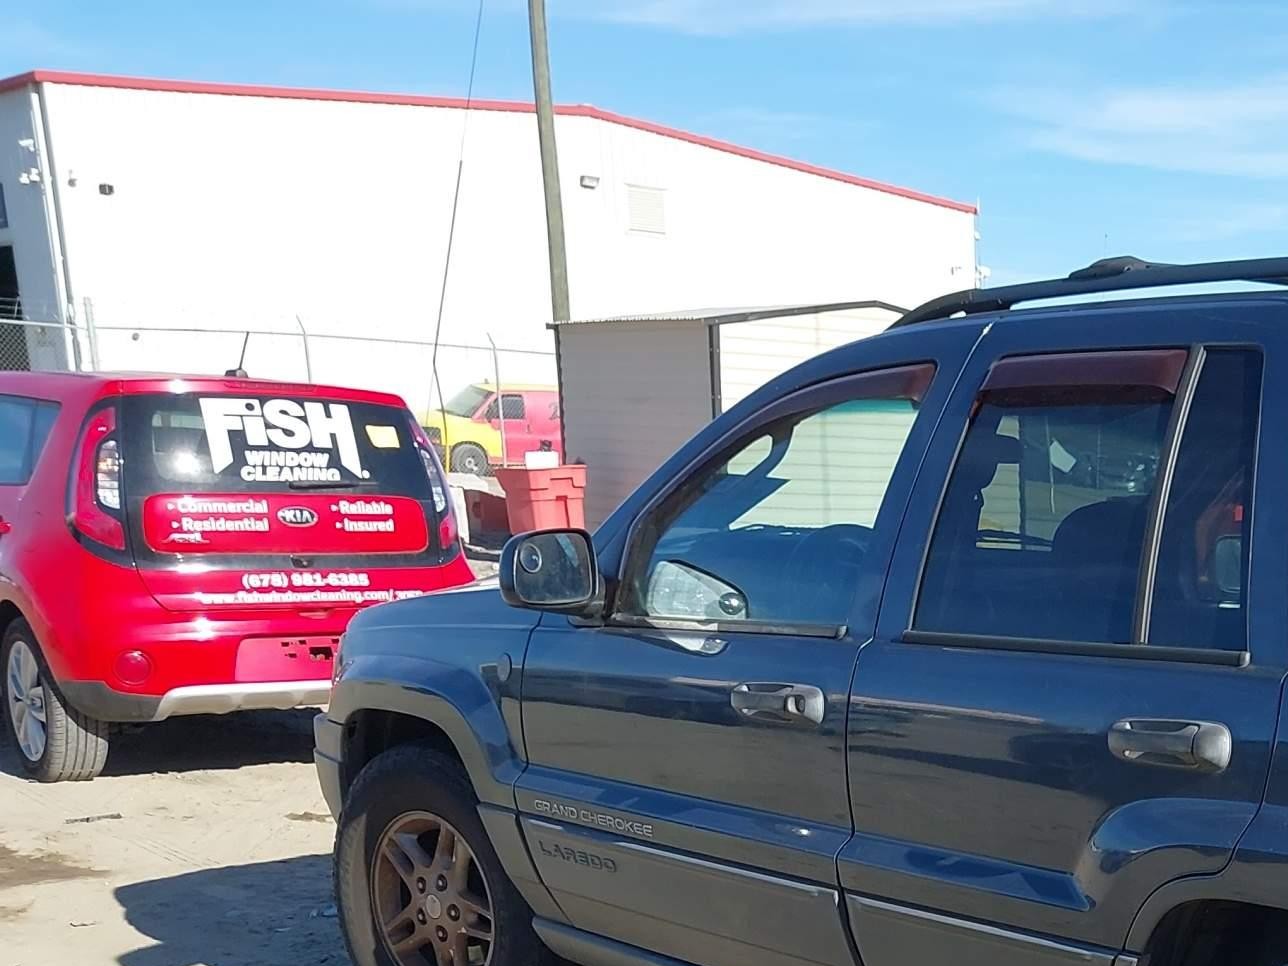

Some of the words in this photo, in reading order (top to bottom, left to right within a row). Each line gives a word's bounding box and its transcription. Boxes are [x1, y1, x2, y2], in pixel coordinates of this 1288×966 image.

[244, 450, 330, 468] WINDOW
[240, 466, 341, 482] CLEANING
[176, 499, 269, 514] Commercial
[338, 500, 394, 515] Reliable
[181, 517, 270, 532] Residential
[343, 518, 395, 532] Insured
[241, 571, 289, 589] (678)
[534, 799, 577, 819] GRAND
[580, 810, 653, 838] CHEROKEE
[538, 840, 618, 873] LAREDO
